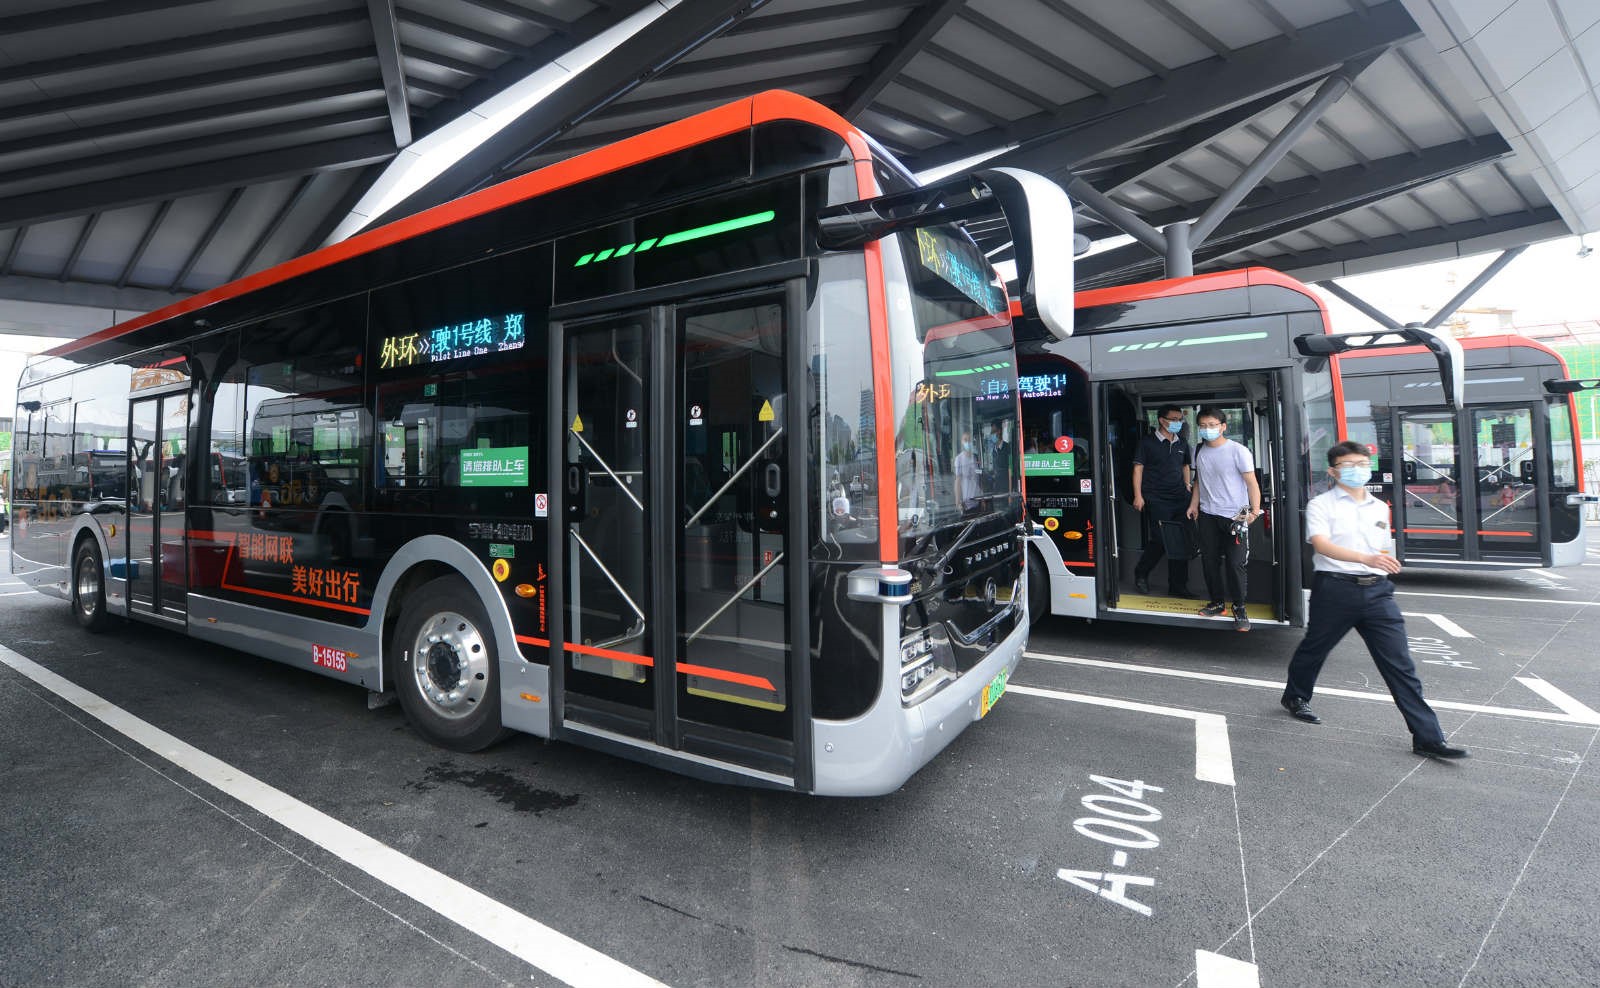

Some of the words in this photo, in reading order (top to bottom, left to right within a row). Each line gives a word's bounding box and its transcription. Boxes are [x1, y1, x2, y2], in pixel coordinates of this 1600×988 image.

[380, 332, 420, 369] 外环
[431, 351, 452, 362] Pilot
[454, 347, 471, 359] Line
[474, 346, 488, 355] One
[1061, 439, 1068, 450] 3
[238, 532, 294, 564] 智能网联
[292, 565, 360, 604] 美好出行
[313, 645, 346, 671] B-15155
[1057, 774, 1164, 916] A-004
